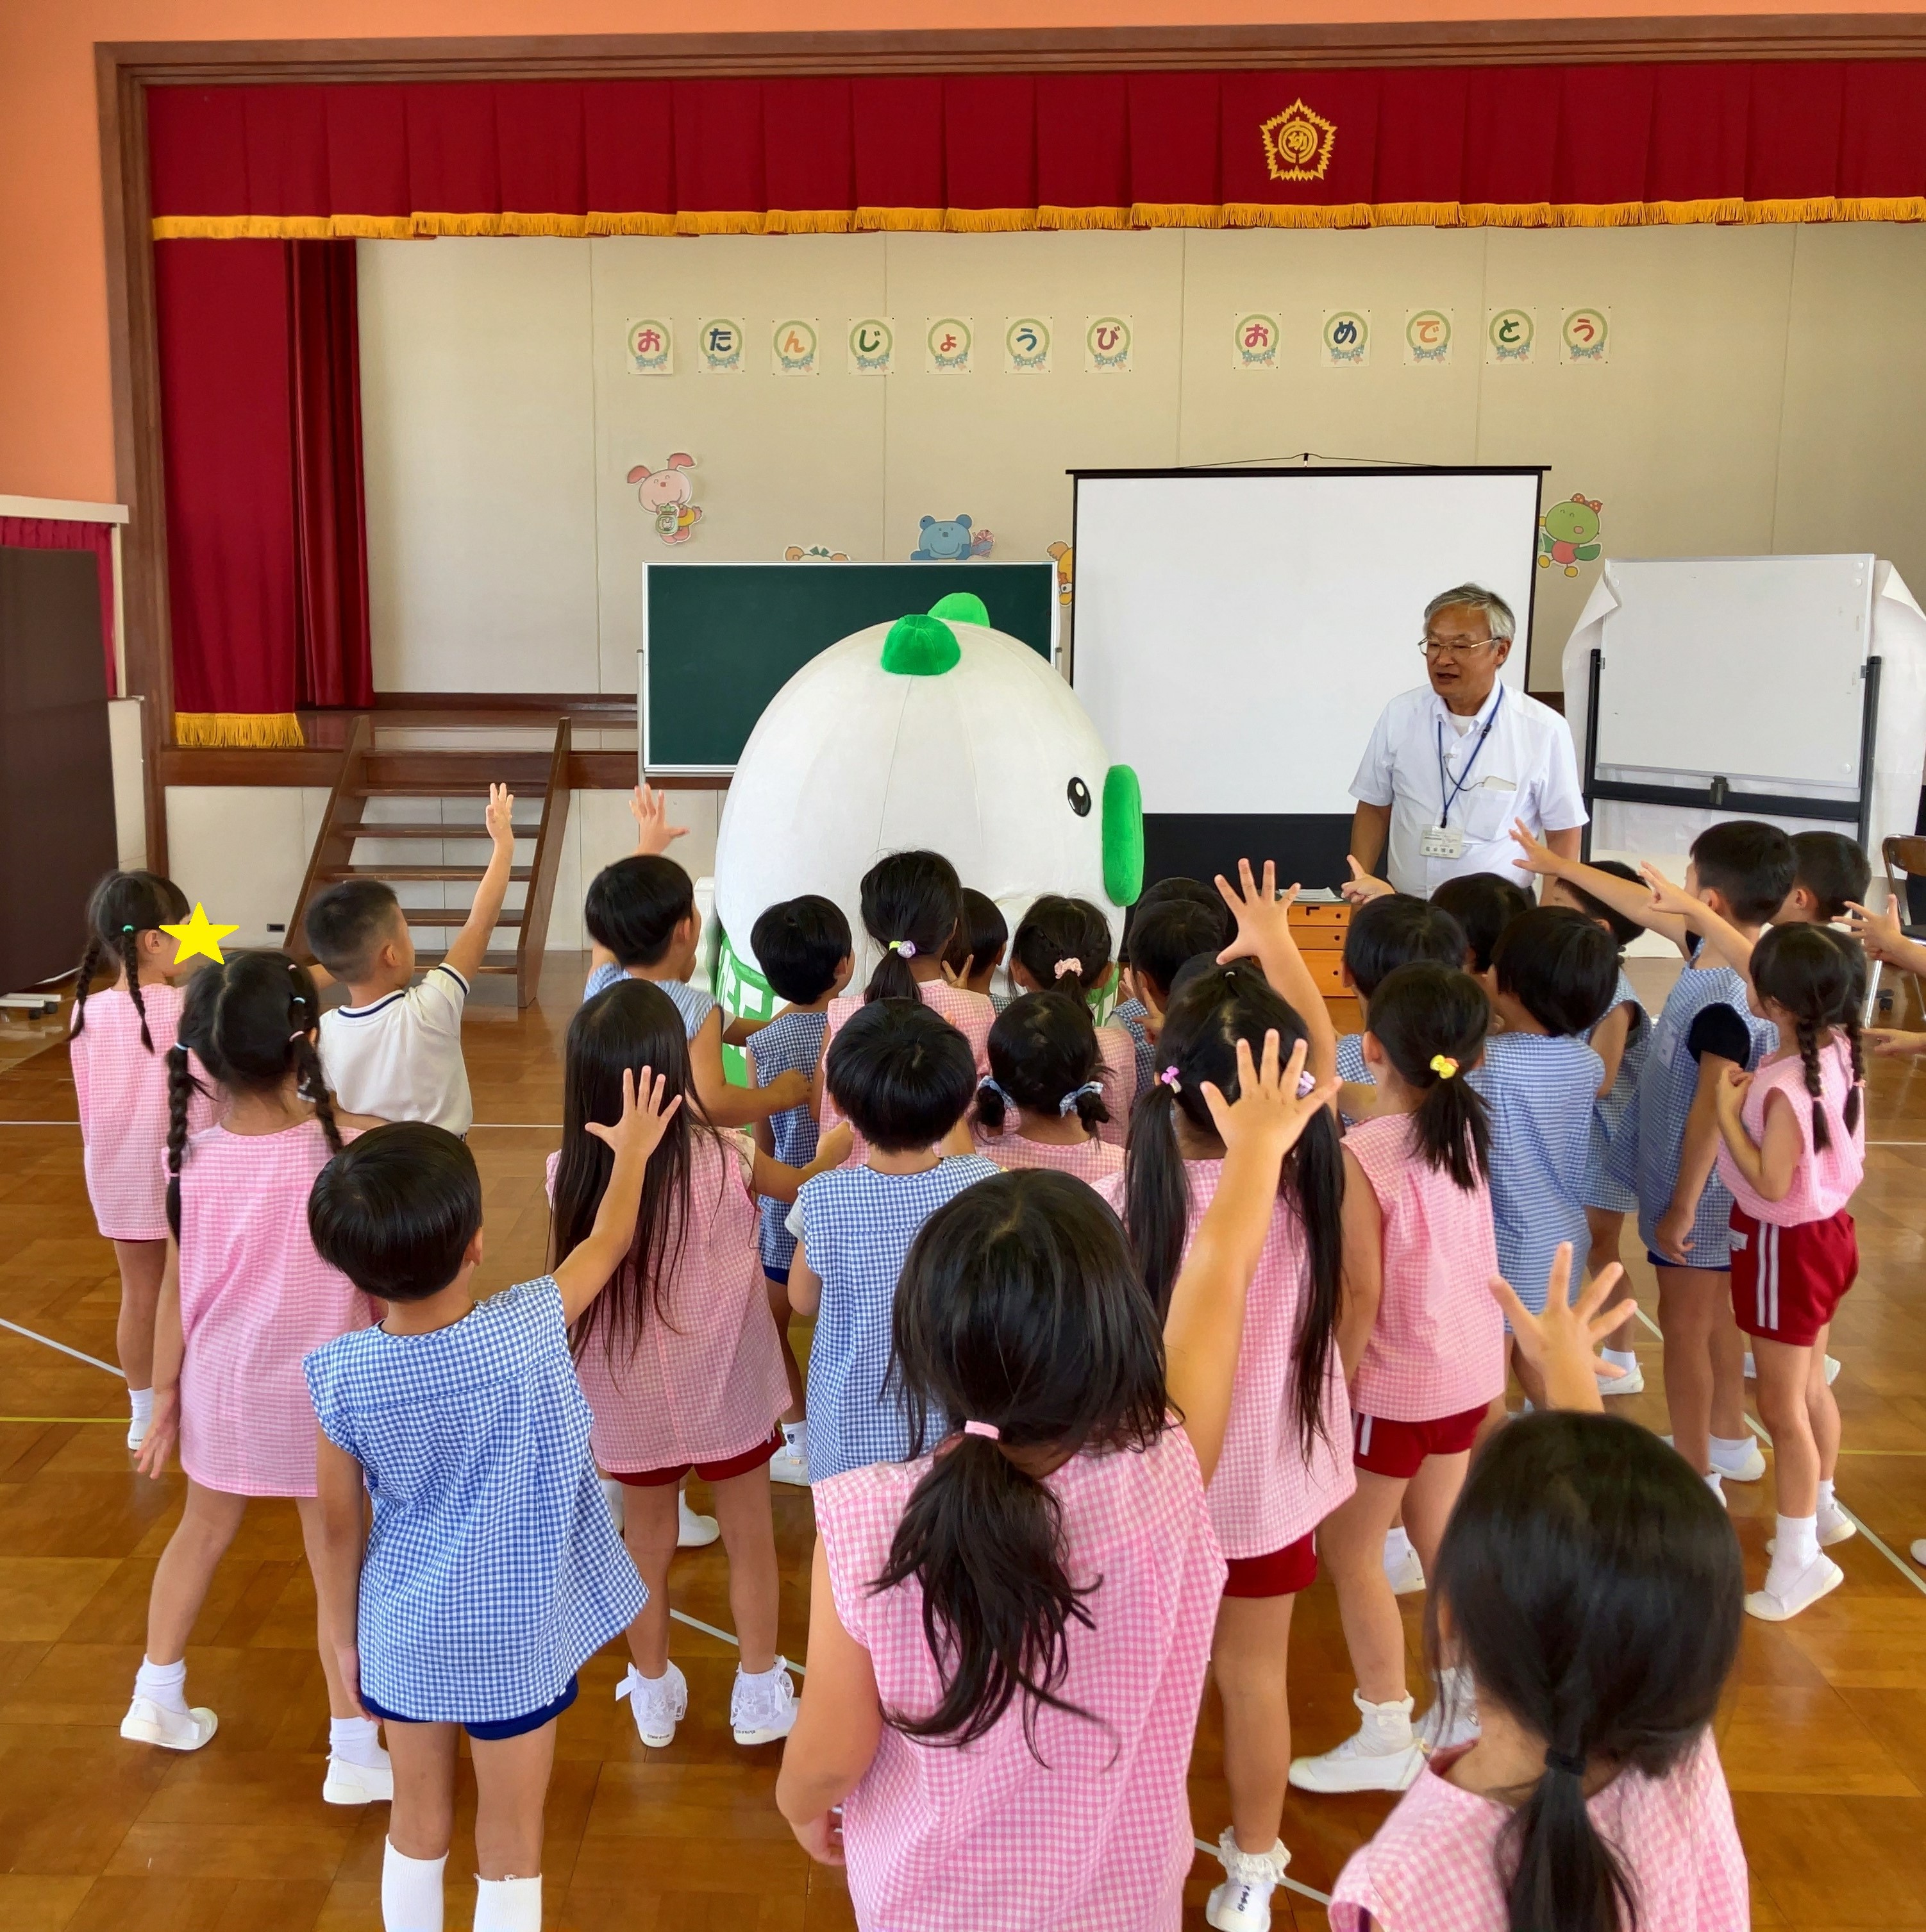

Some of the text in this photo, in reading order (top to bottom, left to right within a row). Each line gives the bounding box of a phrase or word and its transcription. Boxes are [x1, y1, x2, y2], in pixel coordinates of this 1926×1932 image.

[1287, 131, 1308, 151] 幼
[637, 319, 1595, 353] おたんじょうび おめでとう
